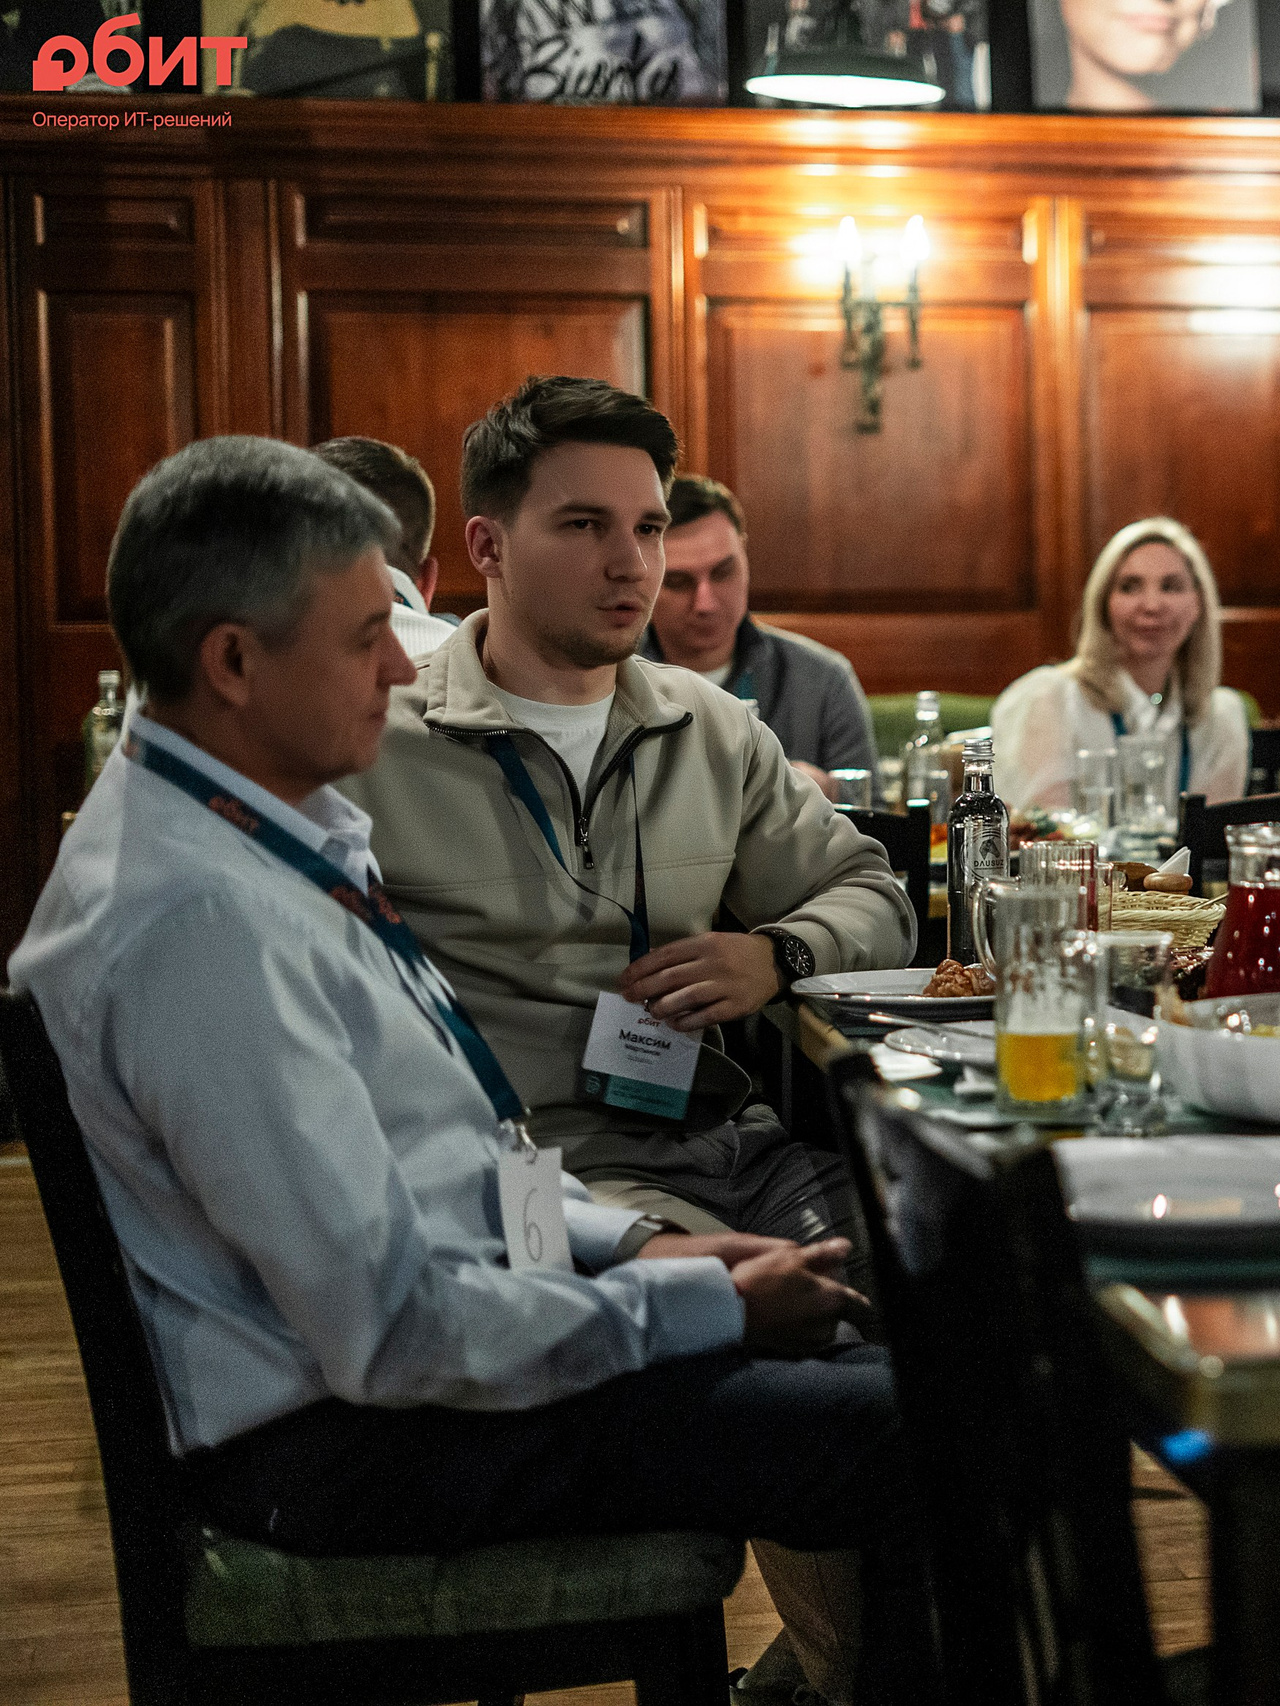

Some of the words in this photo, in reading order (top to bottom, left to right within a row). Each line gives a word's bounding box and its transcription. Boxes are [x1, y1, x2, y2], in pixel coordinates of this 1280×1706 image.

[973, 860, 1004, 868] DAUSUZ
[618, 1029, 671, 1050] Максим
[522, 1187, 543, 1263] 6
